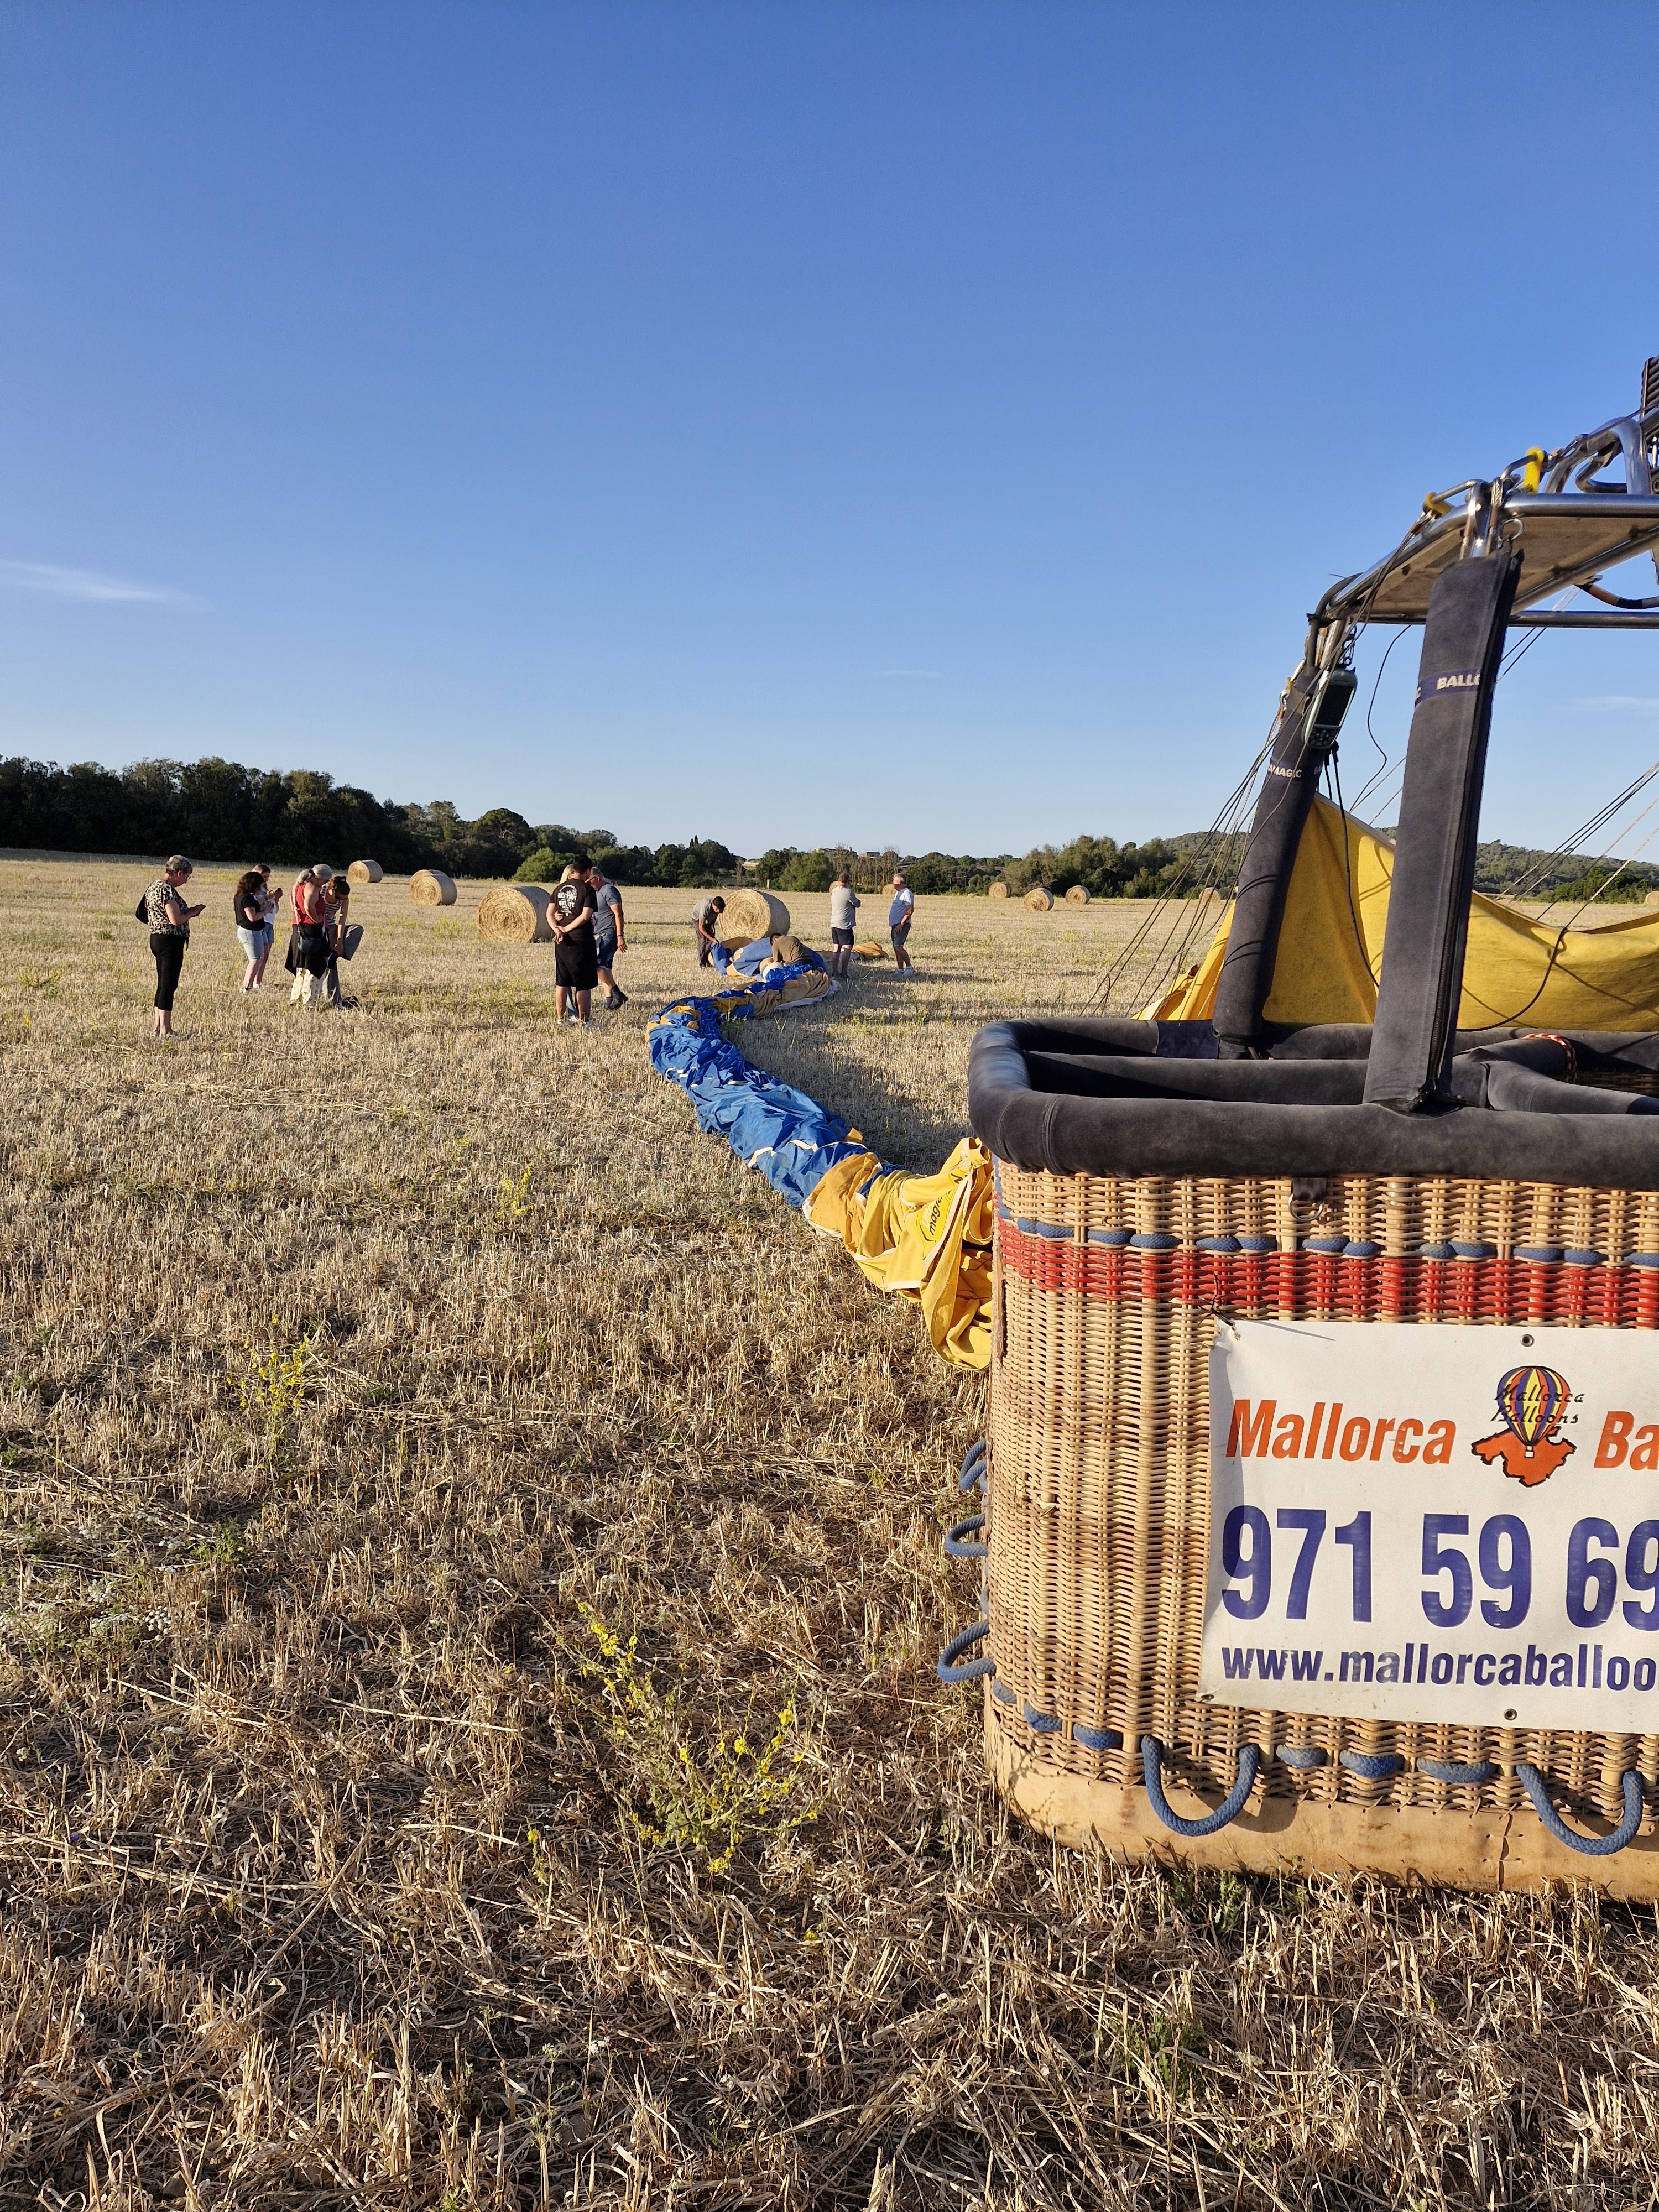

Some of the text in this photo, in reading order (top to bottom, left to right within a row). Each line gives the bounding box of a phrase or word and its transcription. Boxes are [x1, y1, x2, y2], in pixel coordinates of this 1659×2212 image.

[1490, 1405, 1579, 1423] Balloons
[1494, 1384, 1585, 1403] Mallorca
[1225, 1399, 1659, 1470] Mallorca Ba
[1222, 1505, 1659, 1631] 971 59 69
[1222, 1643, 1657, 1692] www.mallorcaballoo
